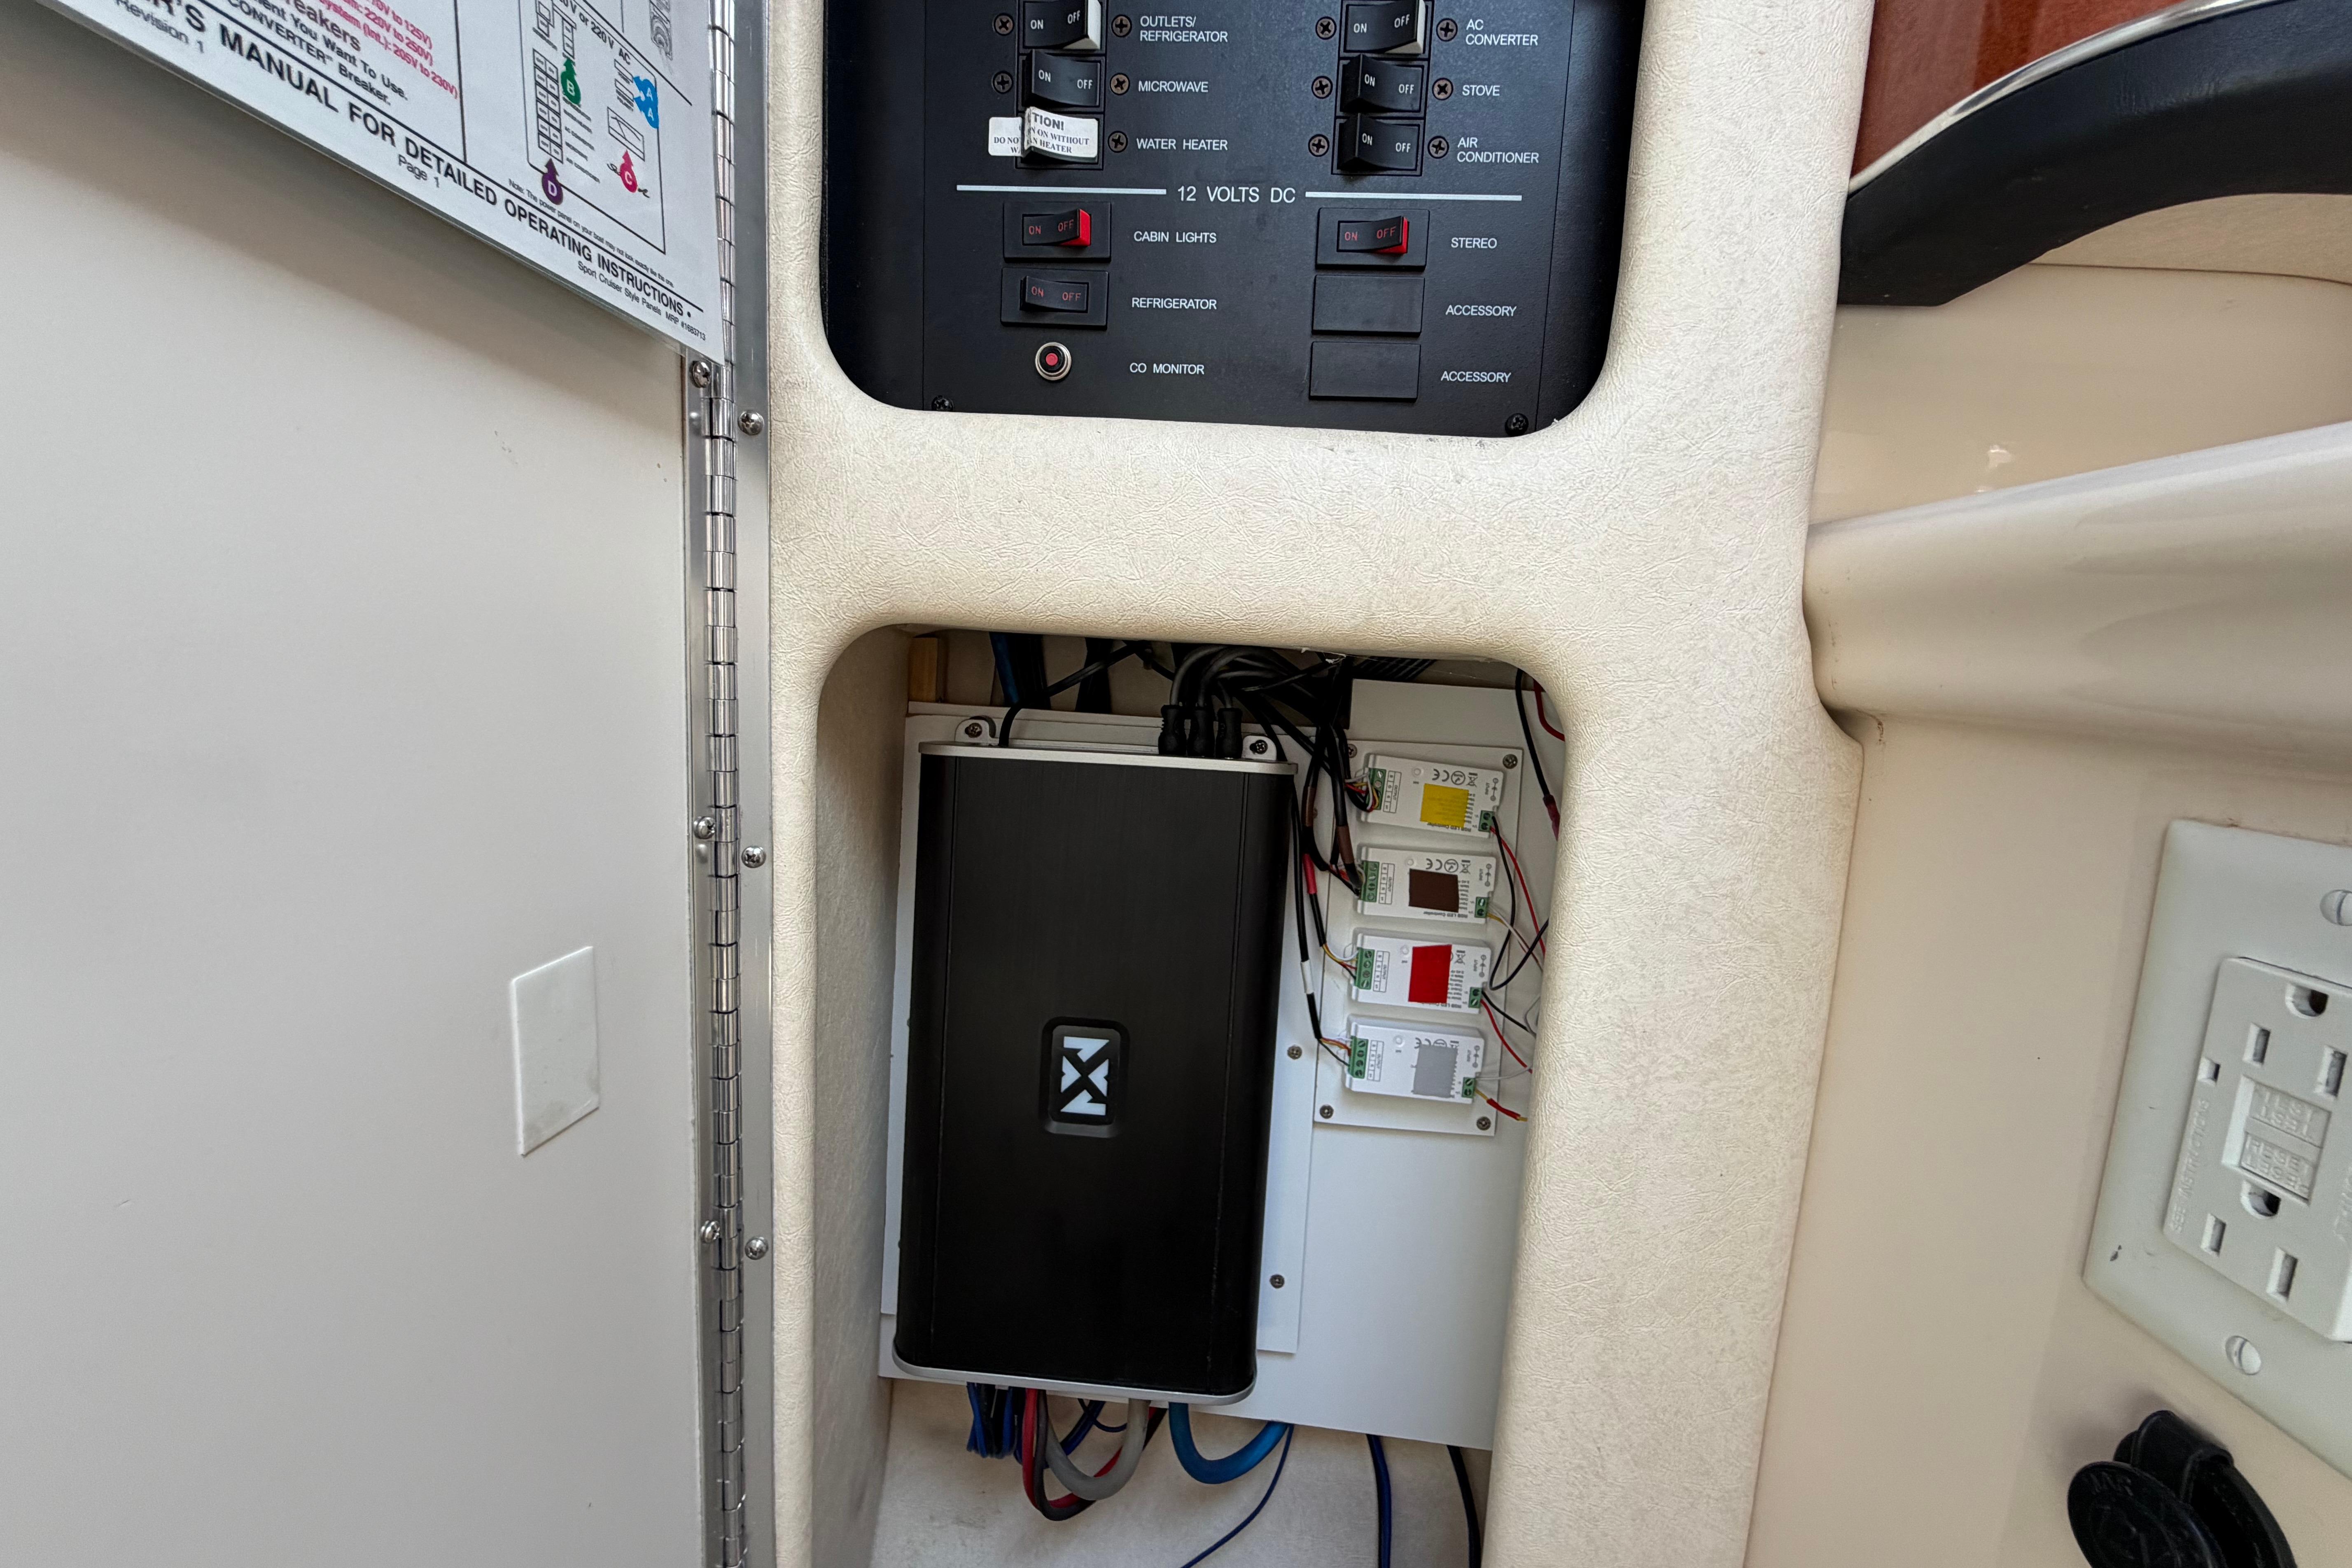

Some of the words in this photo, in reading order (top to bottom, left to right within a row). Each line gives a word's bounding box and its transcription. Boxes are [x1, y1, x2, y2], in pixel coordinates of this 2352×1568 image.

[1030, 19, 1044, 30] ON
[1067, 10, 1081, 25] OFF
[1140, 16, 1197, 28] OUTLETS/
[1353, 23, 1367, 34] ON
[1394, 14, 1410, 29] OFF
[1466, 19, 1484, 31] AC
[364, 7, 391, 32] 220V
[393, 28, 404, 42] to
[406, 36, 433, 66] 250V)
[392, 10, 403, 25] to
[405, 20, 432, 49] 125V)
[569, 0, 576, 14] V
[579, 12, 589, 26] or
[591, 21, 607, 43] 220
[608, 36, 614, 49] V
[618, 48, 631, 65] AC
[1140, 30, 1228, 42] REFRIGERATOR
[196, 40, 204, 53] 1
[1465, 34, 1539, 47] CONVERTER
[290, 14, 317, 41] You
[322, 35, 358, 67] Want
[360, 60, 377, 79] To
[381, 74, 408, 101] Use.
[393, 43, 418, 68] 205V
[420, 63, 431, 78] to
[432, 71, 458, 99] 230V)
[338, 63, 391, 105] Breaker.
[567, 79, 575, 96] B
[1038, 69, 1051, 83] ON
[1076, 79, 1093, 90] OFF
[1138, 81, 1209, 93] MICROWAVE
[1364, 74, 1376, 87] ON
[1398, 84, 1415, 95] OFF
[1462, 85, 1500, 97] STOVE
[647, 107, 655, 121] A
[1019, 112, 1064, 131] TION!
[1037, 128, 1048, 139] ON
[1050, 132, 1090, 145] WITHOUT
[1136, 138, 1176, 150] WATER
[1183, 138, 1228, 151] HEATER
[1362, 133, 1373, 146] ON
[1395, 142, 1411, 153] OFF
[1457, 137, 1478, 149] AIR
[1040, 138, 1072, 154] HEATER
[1457, 152, 1539, 164] CONDITIONER
[219, 23, 339, 113] MANUAL
[348, 101, 396, 147] FOR
[405, 136, 497, 205] DETAILED
[504, 198, 593, 264] OPERATING
[597, 253, 684, 317] INSTRUCTIONS
[398, 154, 427, 181] Page
[434, 177, 439, 188] 1
[625, 170, 633, 185] C
[548, 180, 557, 197] D
[1177, 187, 1197, 202] 12
[1206, 187, 1260, 203] VOLTS
[1270, 188, 1296, 203] DC
[526, 188, 538, 203] The
[539, 198, 556, 214] power
[557, 208, 572, 223] panel
[573, 219, 581, 228] on
[581, 224, 593, 237] your
[1029, 225, 1042, 235] ON
[1057, 219, 1075, 233] OFF
[1344, 231, 1358, 241] ON
[1376, 226, 1397, 239] OFF
[1134, 231, 1169, 243] CABIN
[1176, 232, 1217, 243] LIGHTS
[1451, 237, 1498, 249] STEREO
[578, 260, 597, 280] Sport
[599, 273, 622, 293] Cruiser
[624, 288, 639, 303] Style
[642, 297, 662, 316] Panels
[665, 311, 679, 325] MRP
[1031, 287, 1044, 298] ON
[1062, 292, 1081, 301] OFF
[1132, 297, 1217, 310] REFRIGERATOR
[1445, 305, 1517, 317] ACCESSORY
[1129, 362, 1147, 373] CO
[1153, 363, 1205, 376] MONITOR
[1441, 371, 1512, 383] ACCESSORY
